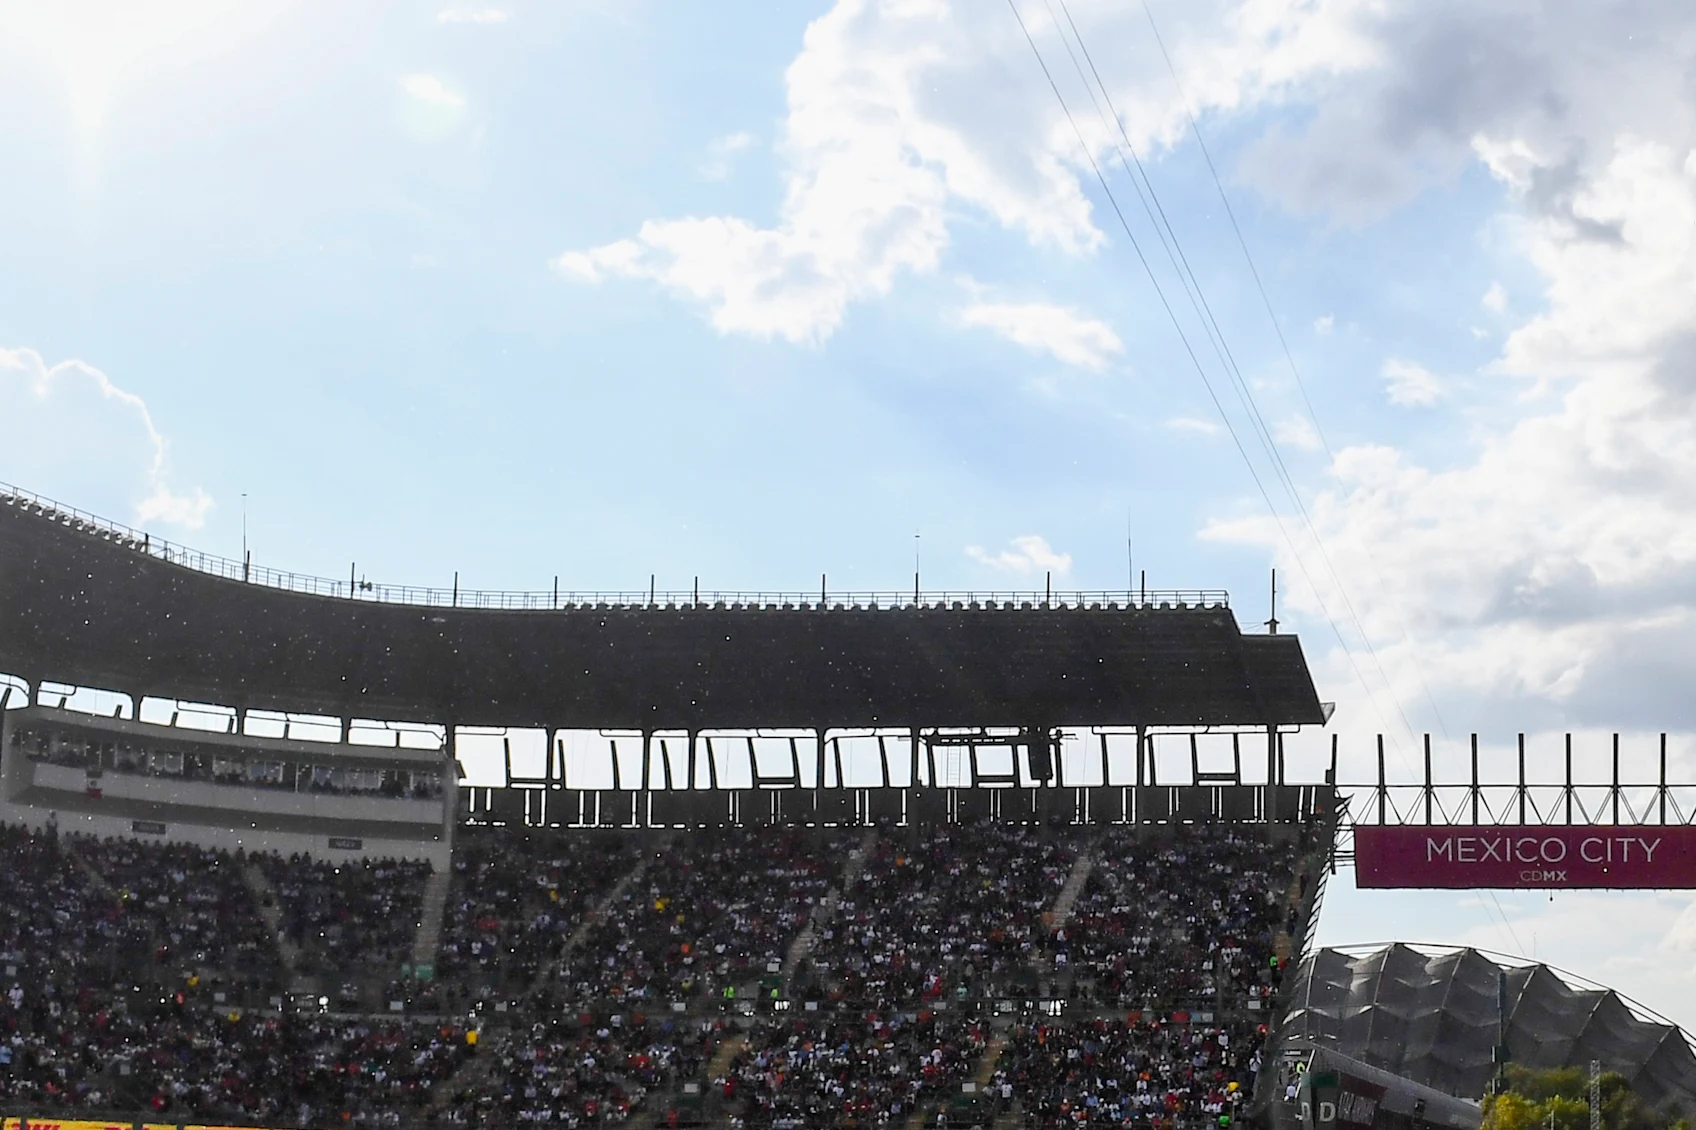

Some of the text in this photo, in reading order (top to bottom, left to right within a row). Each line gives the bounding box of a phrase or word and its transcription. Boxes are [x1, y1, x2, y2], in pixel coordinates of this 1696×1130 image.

[1427, 837, 1662, 863] MEXICO CITY
[1520, 870, 1567, 882] CDMX
